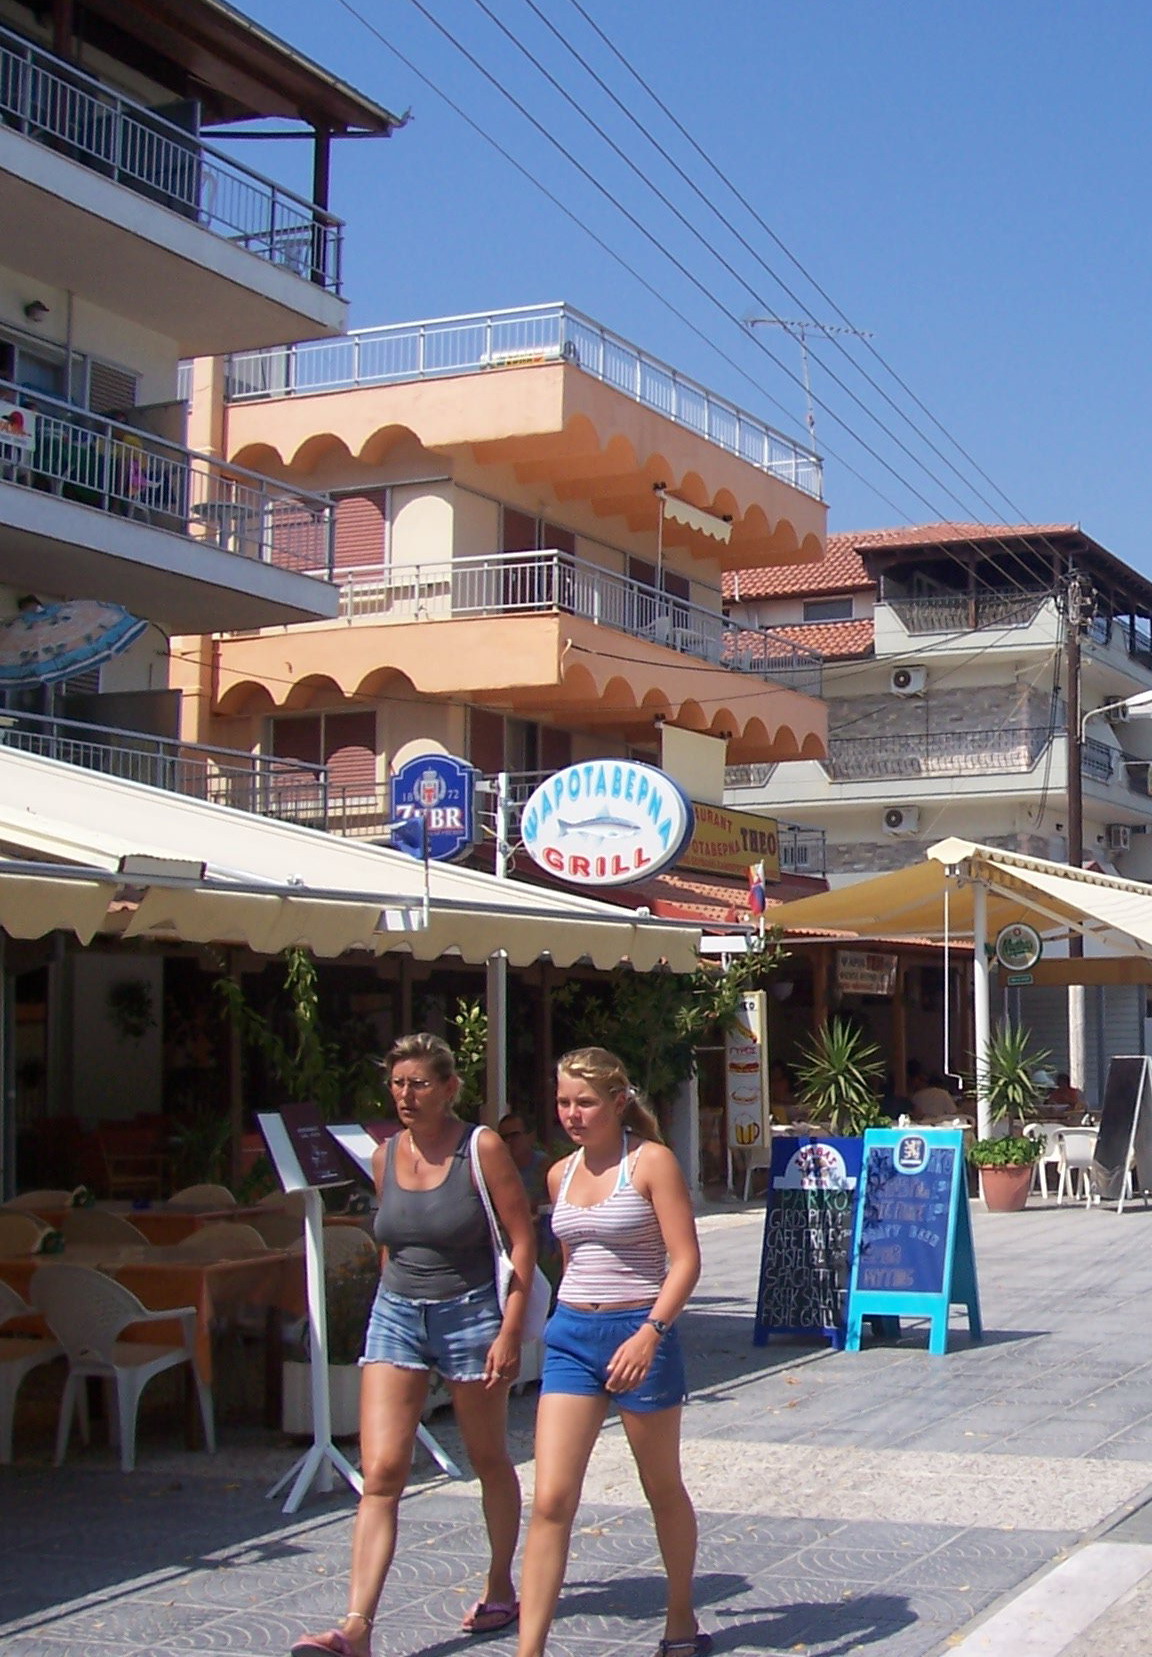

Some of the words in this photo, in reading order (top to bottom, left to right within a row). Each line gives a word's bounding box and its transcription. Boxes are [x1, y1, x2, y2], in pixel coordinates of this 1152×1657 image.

[524, 764, 672, 851] ΨΑΡΟΤΑΒΕΡΝΑ
[543, 847, 651, 877] GRILL
[766, 1228, 799, 1249] CAFE
